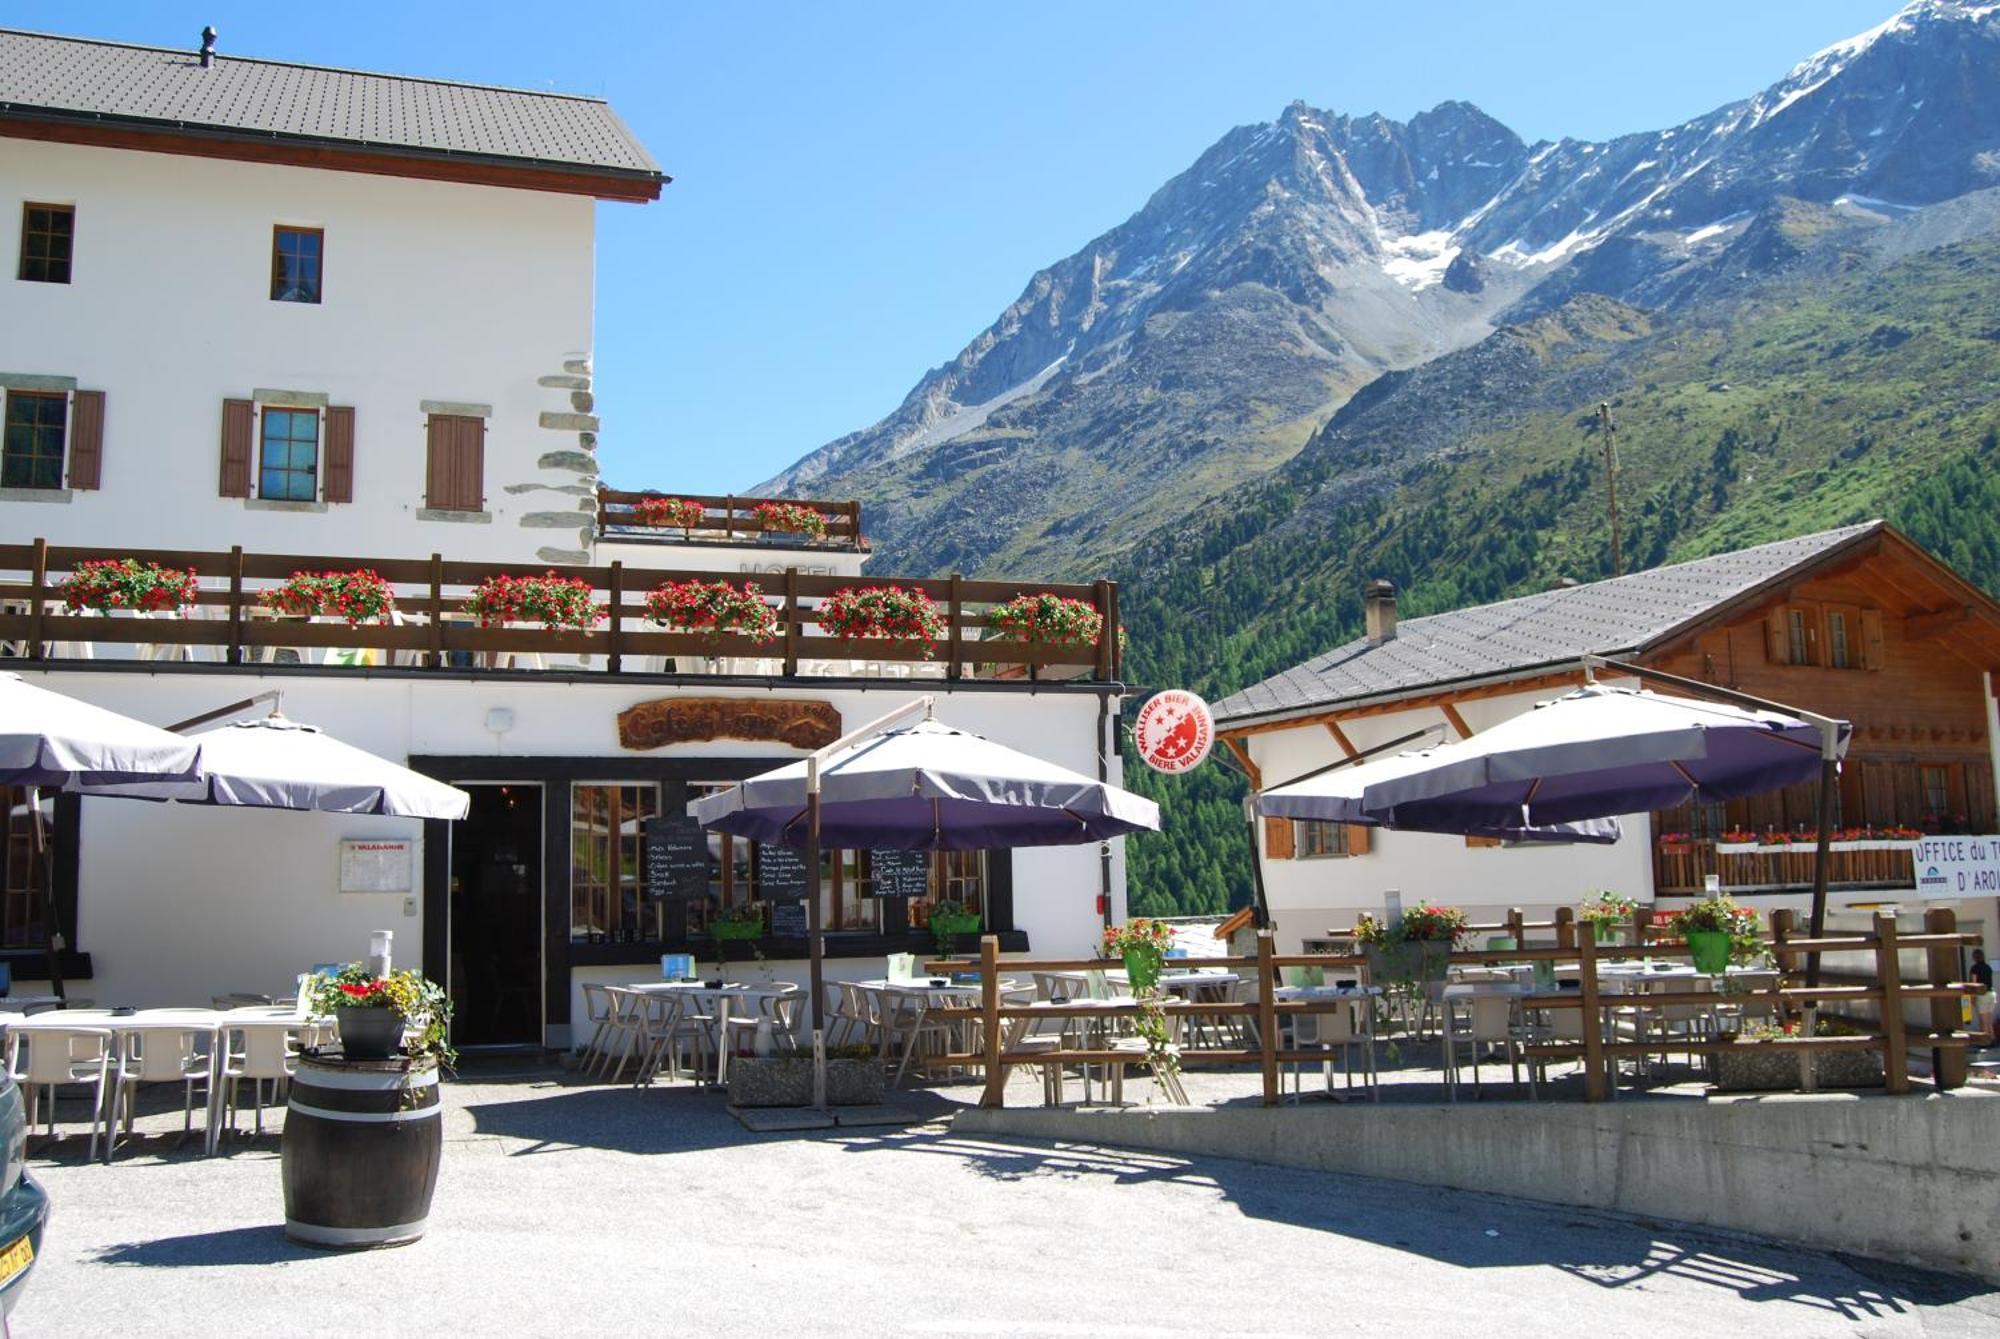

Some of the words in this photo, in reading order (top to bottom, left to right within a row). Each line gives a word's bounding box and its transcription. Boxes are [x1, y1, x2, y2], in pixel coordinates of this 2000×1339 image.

[1138, 698, 1161, 754] WALLISER
[1165, 694, 1190, 705] BIER
[1916, 841, 1965, 862] OFFICE
[1970, 840, 1985, 860] du
[1990, 840, 2000, 860] T
